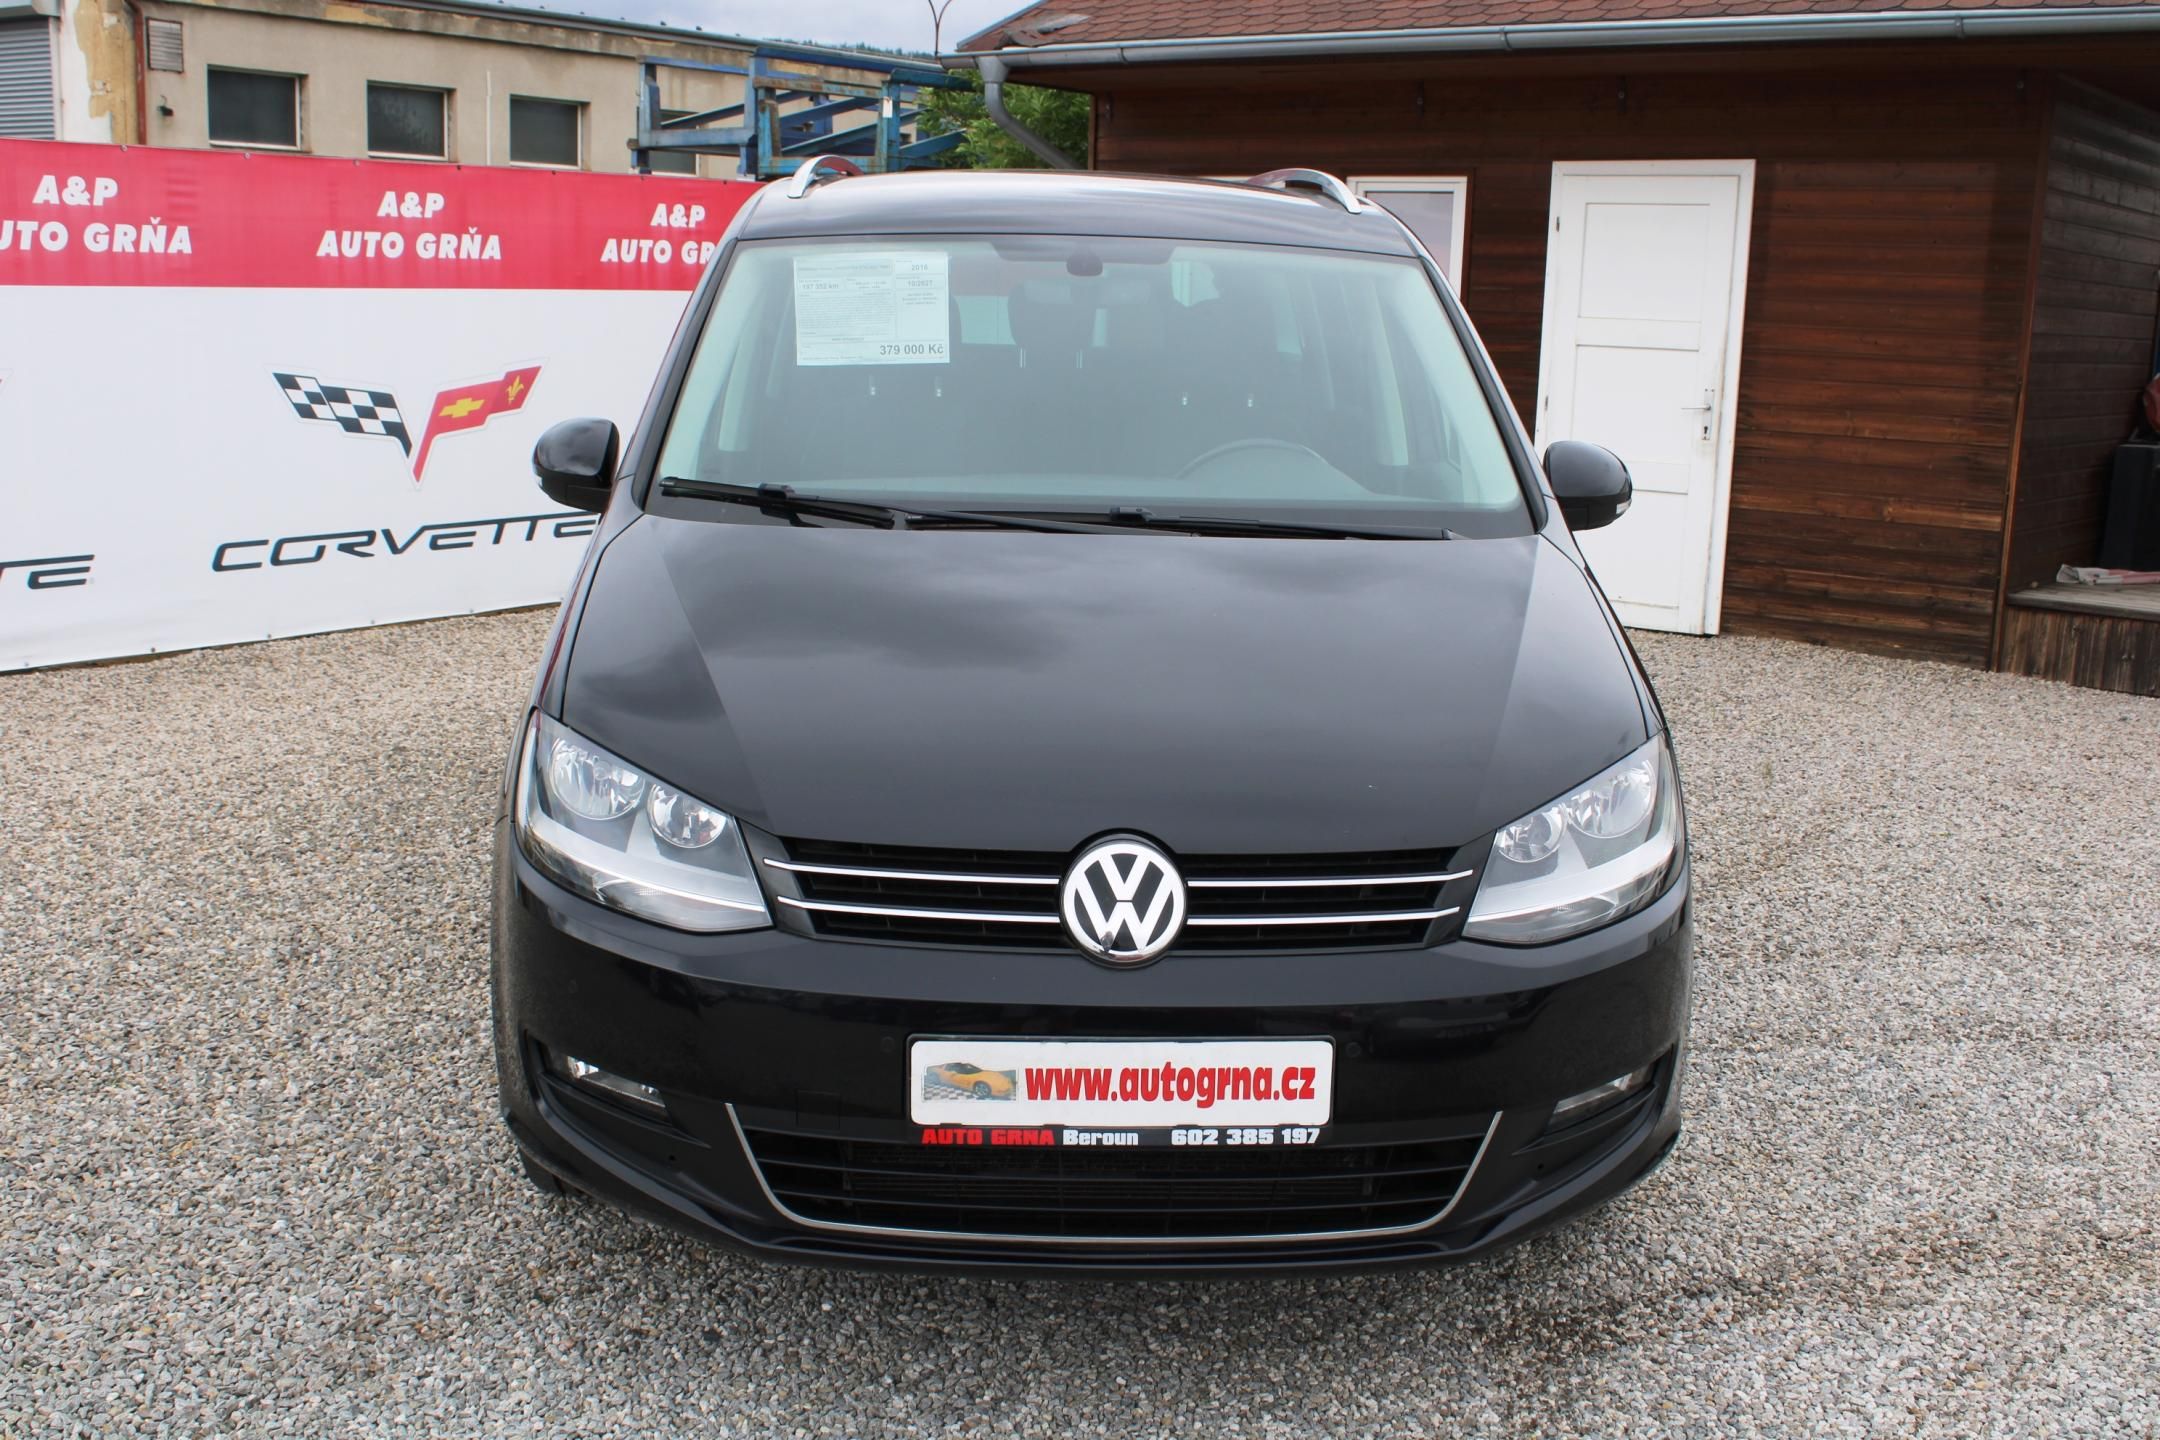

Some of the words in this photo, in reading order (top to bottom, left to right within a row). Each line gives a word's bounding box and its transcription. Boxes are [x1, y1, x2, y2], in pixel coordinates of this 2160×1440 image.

[32, 175, 119, 206] A&P
[377, 191, 445, 218] A&P
[650, 203, 706, 228] A&P
[83, 217, 192, 254] GRŇA
[316, 230, 405, 258] AUTO
[415, 226, 501, 260] GRŇA
[600, 238, 672, 263] AUTO
[880, 344, 900, 355] 379
[904, 344, 925, 355] 000
[928, 343, 944, 354] Kč
[212, 511, 597, 572] CORVETTE
[1025, 1062, 1316, 1108] www.autogrna.cz
[921, 1128, 983, 1145] AUTO
[991, 1129, 1055, 1145] GRNA
[1062, 1129, 1139, 1146] Beroun
[1171, 1129, 1219, 1145] 602
[1226, 1128, 1274, 1145] 385
[1281, 1128, 1320, 1145] 197
